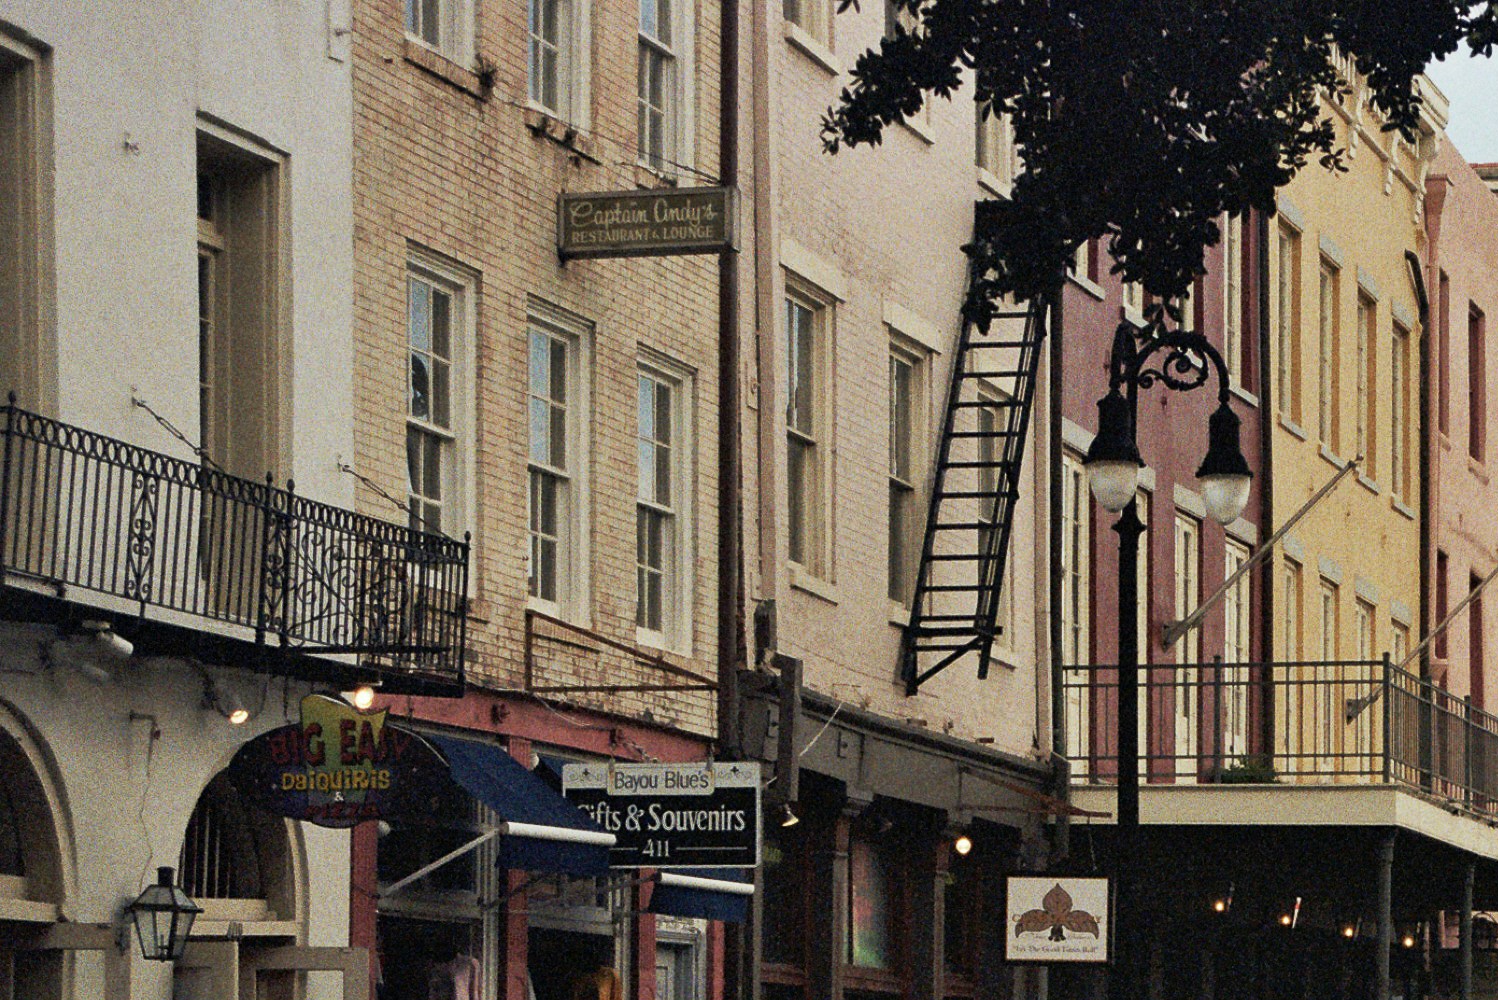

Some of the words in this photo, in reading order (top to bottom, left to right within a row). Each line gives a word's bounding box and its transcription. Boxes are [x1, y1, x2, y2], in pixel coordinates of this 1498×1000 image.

[570, 201, 649, 227] Captain
[653, 198, 718, 224] Andy's
[571, 227, 649, 243] RESTAURANT
[663, 225, 714, 240] LOUNGE
[268, 722, 325, 766] BIG
[340, 719, 412, 764] EASY
[614, 771, 658, 793] Bayou
[664, 771, 709, 789] Blue's
[304, 802, 383, 820] PIZZA
[577, 801, 621, 832] ifts
[625, 804, 645, 832] &
[648, 803, 746, 832] Souvenirs
[642, 839, 670, 858] 411
